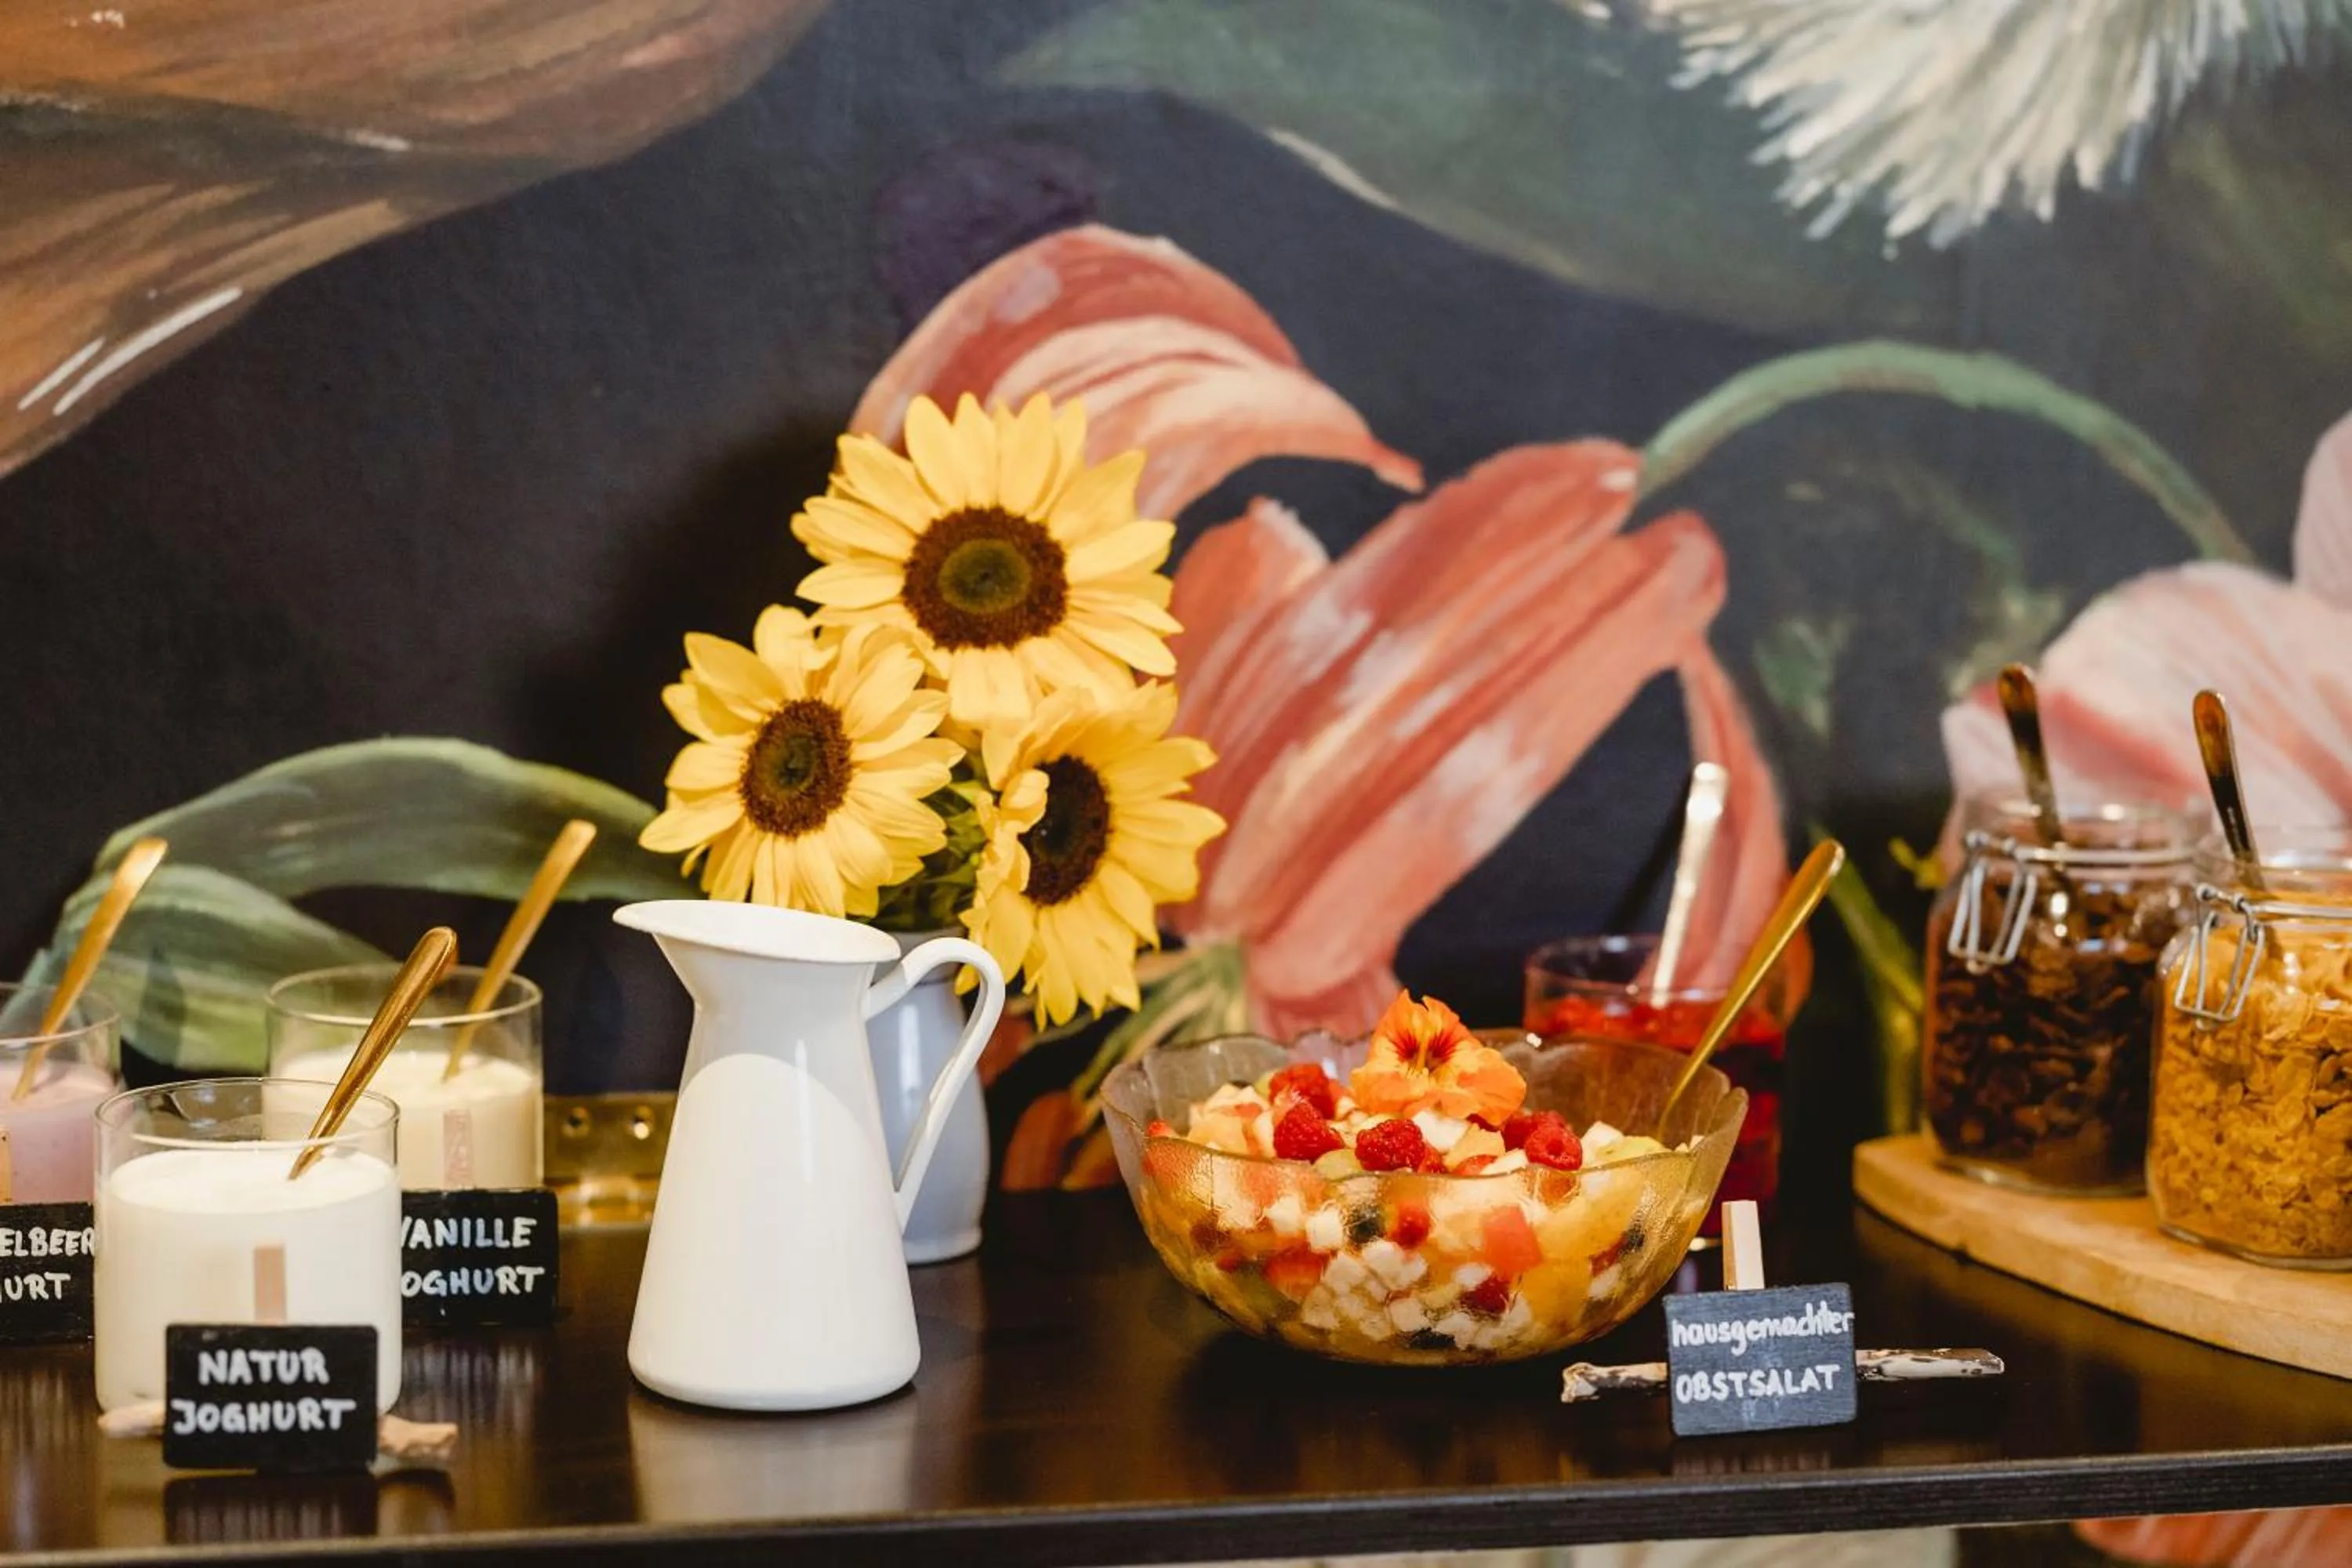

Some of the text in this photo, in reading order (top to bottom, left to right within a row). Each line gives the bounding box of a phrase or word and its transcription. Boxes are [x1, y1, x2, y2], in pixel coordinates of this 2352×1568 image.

[0, 1271, 71, 1301] URT
[401, 1265, 546, 1297] OGHURT
[1671, 1300, 1855, 1356] hausgemachter
[198, 1346, 330, 1386] NATUR
[1675, 1364, 1841, 1404] OBSTSALAT
[170, 1397, 357, 1435] JOGHURT
